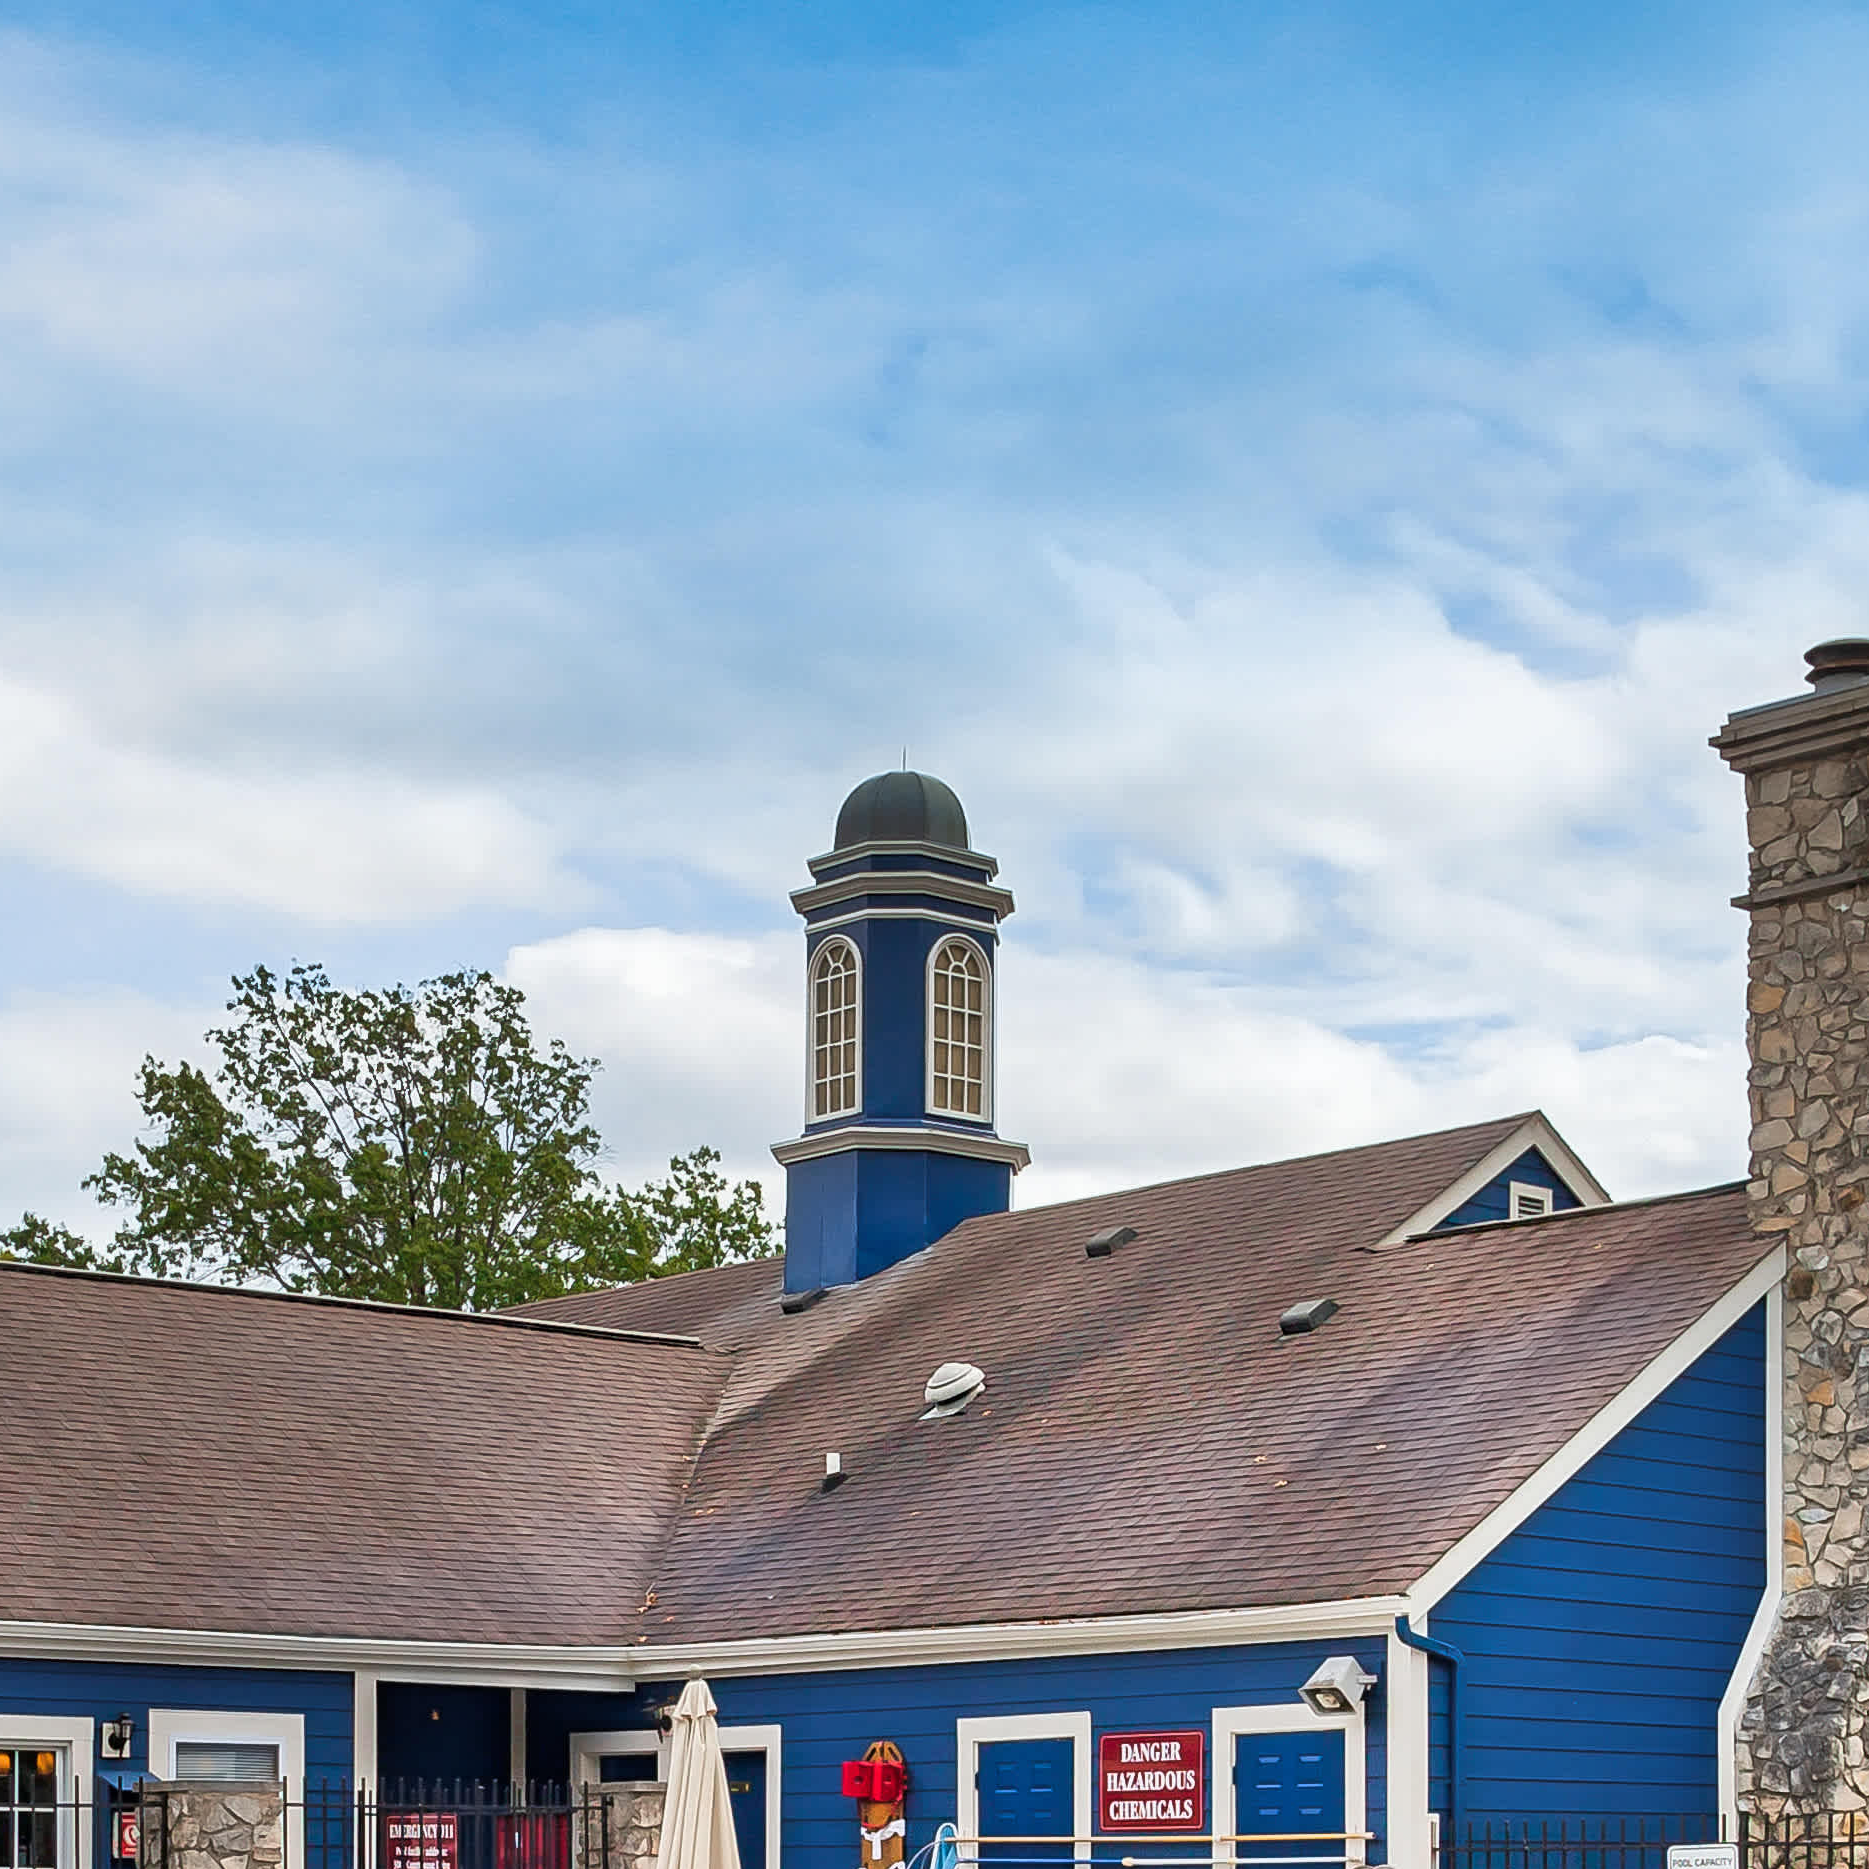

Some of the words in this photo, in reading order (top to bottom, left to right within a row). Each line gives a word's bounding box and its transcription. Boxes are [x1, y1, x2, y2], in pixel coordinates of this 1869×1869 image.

[1120, 1741, 1181, 1763] DANGER
[1106, 1769, 1196, 1792] HAZARDOUS
[1109, 1799, 1193, 1820] CHEMICALS
[1672, 1858, 1693, 1868] POOL
[1694, 1857, 1733, 1868] CAPACITY
